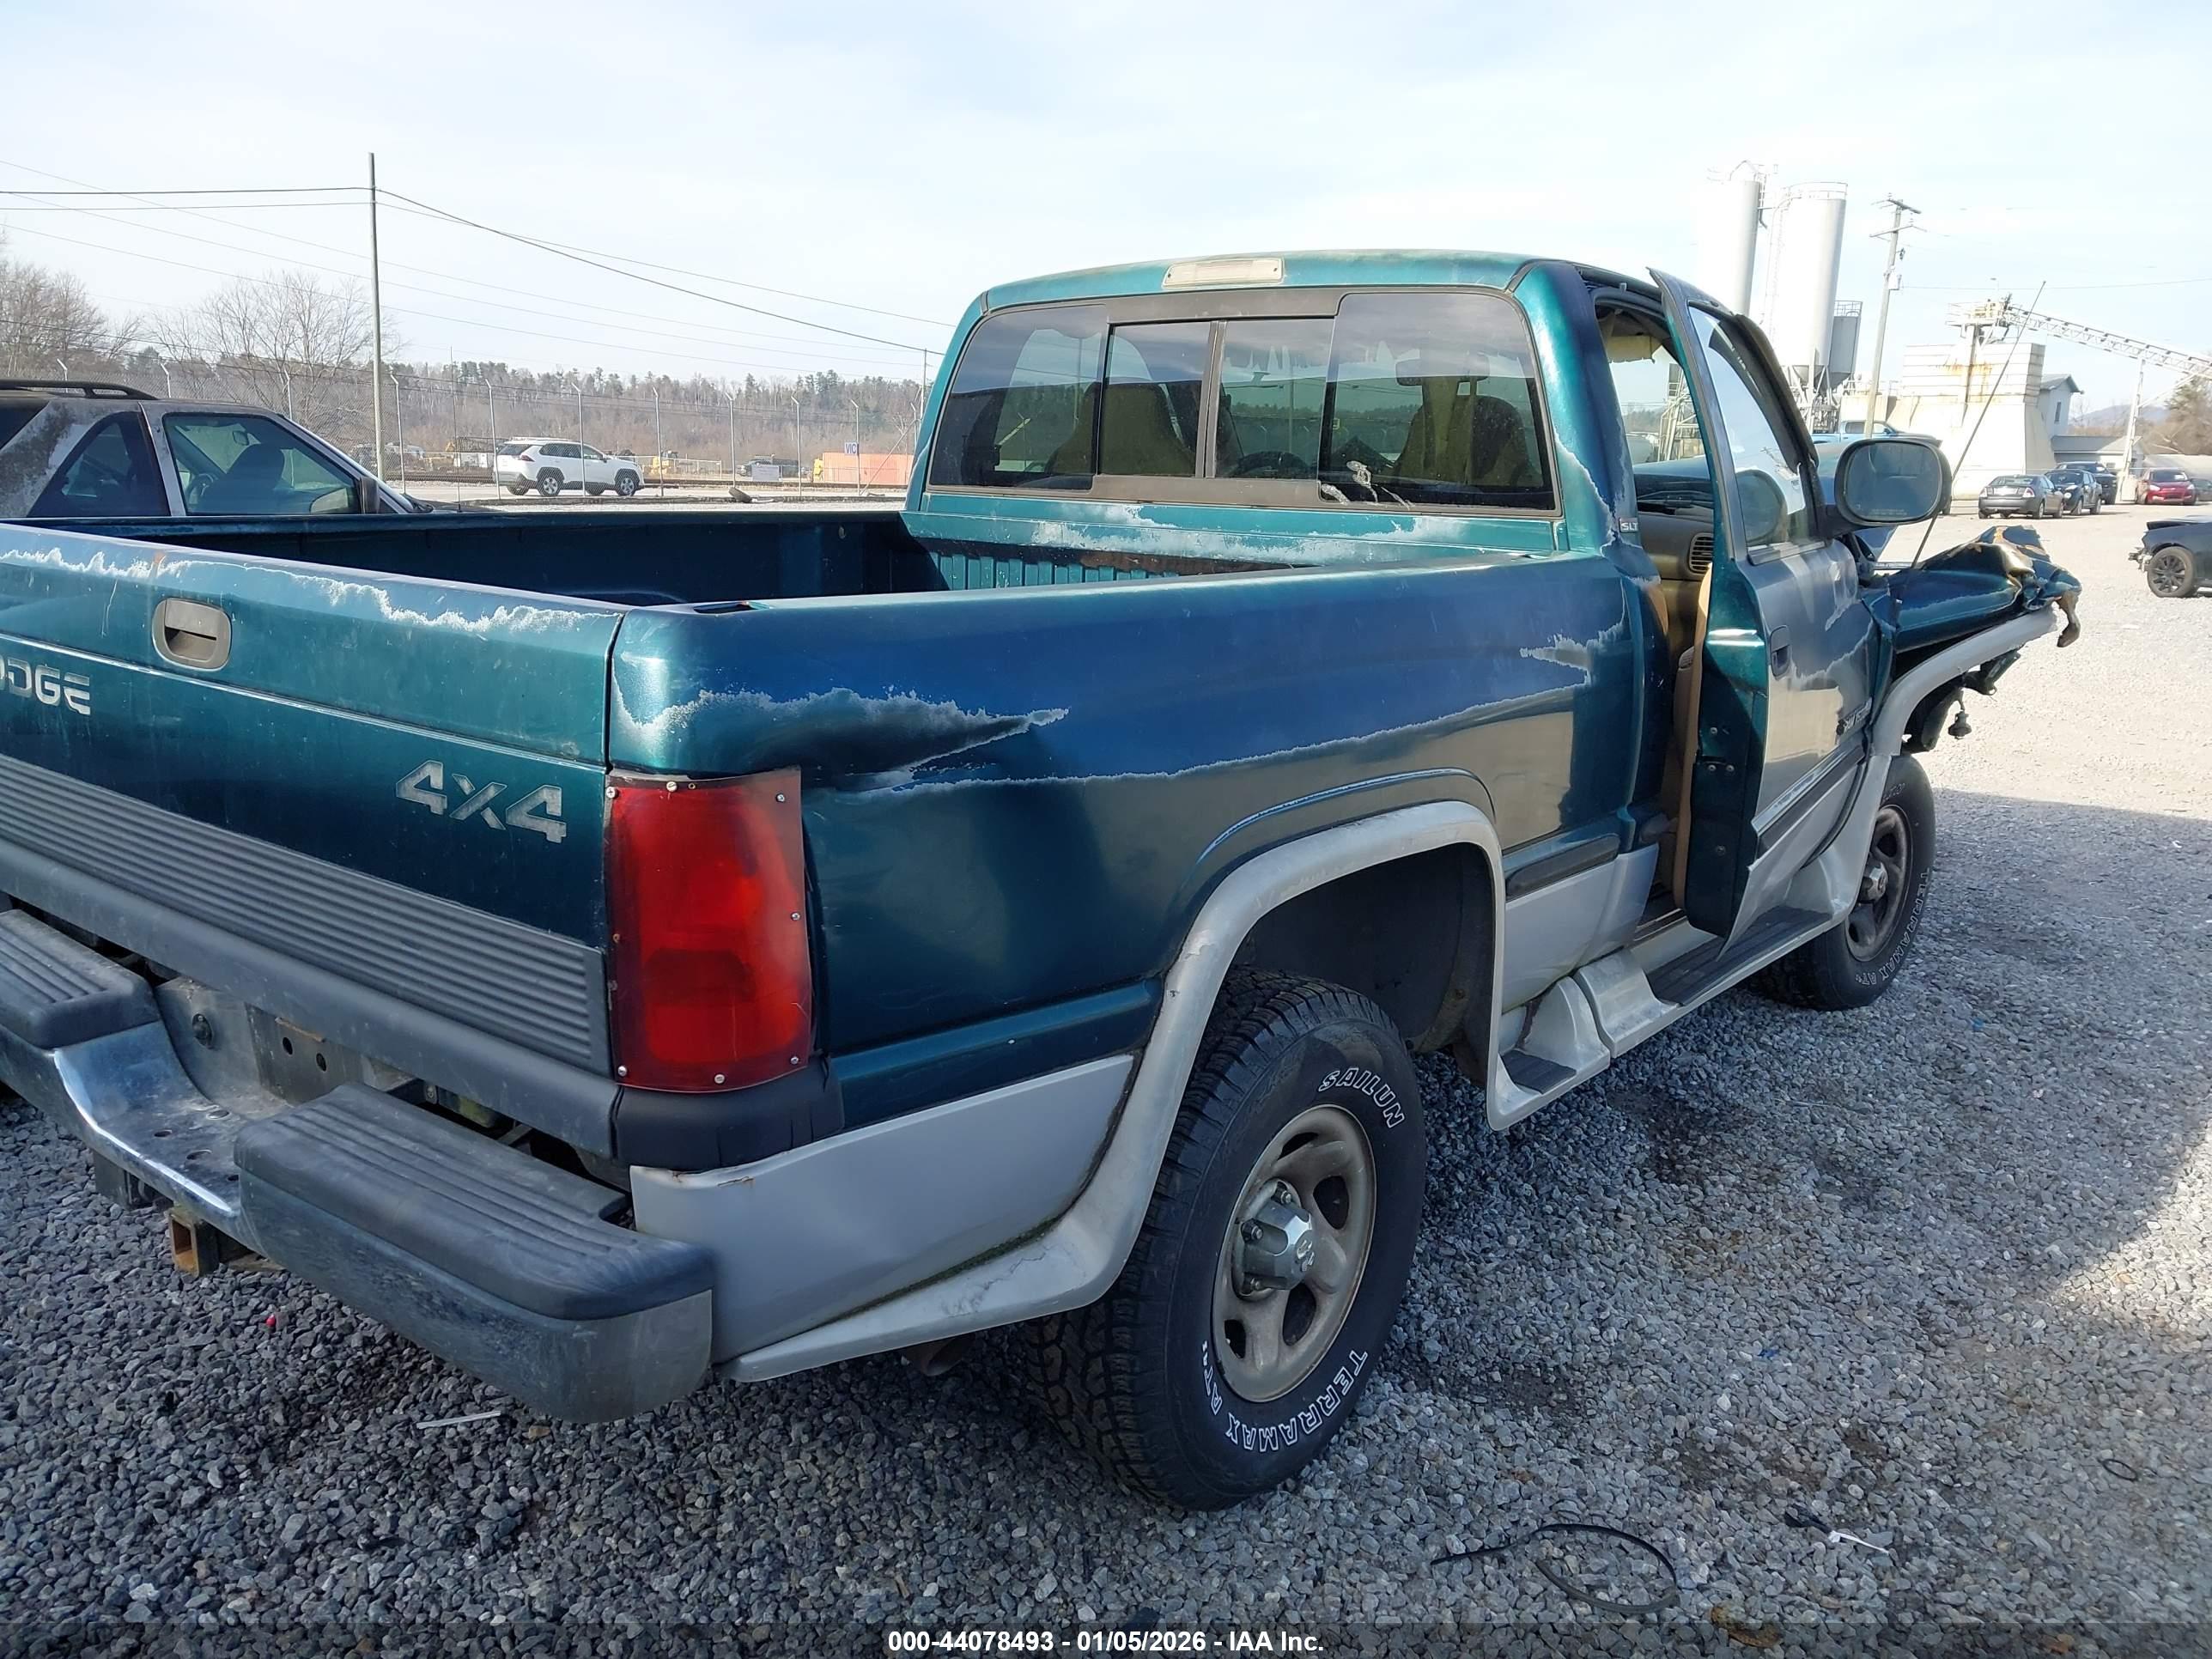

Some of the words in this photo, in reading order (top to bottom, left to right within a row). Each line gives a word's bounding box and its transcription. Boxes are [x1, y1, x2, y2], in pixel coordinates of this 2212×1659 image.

[1620, 522, 1638, 531] SLT
[0, 655, 91, 715] DGE
[1318, 1067, 1405, 1128] SAILUN
[1225, 1350, 1369, 1452] TERRAMAX
